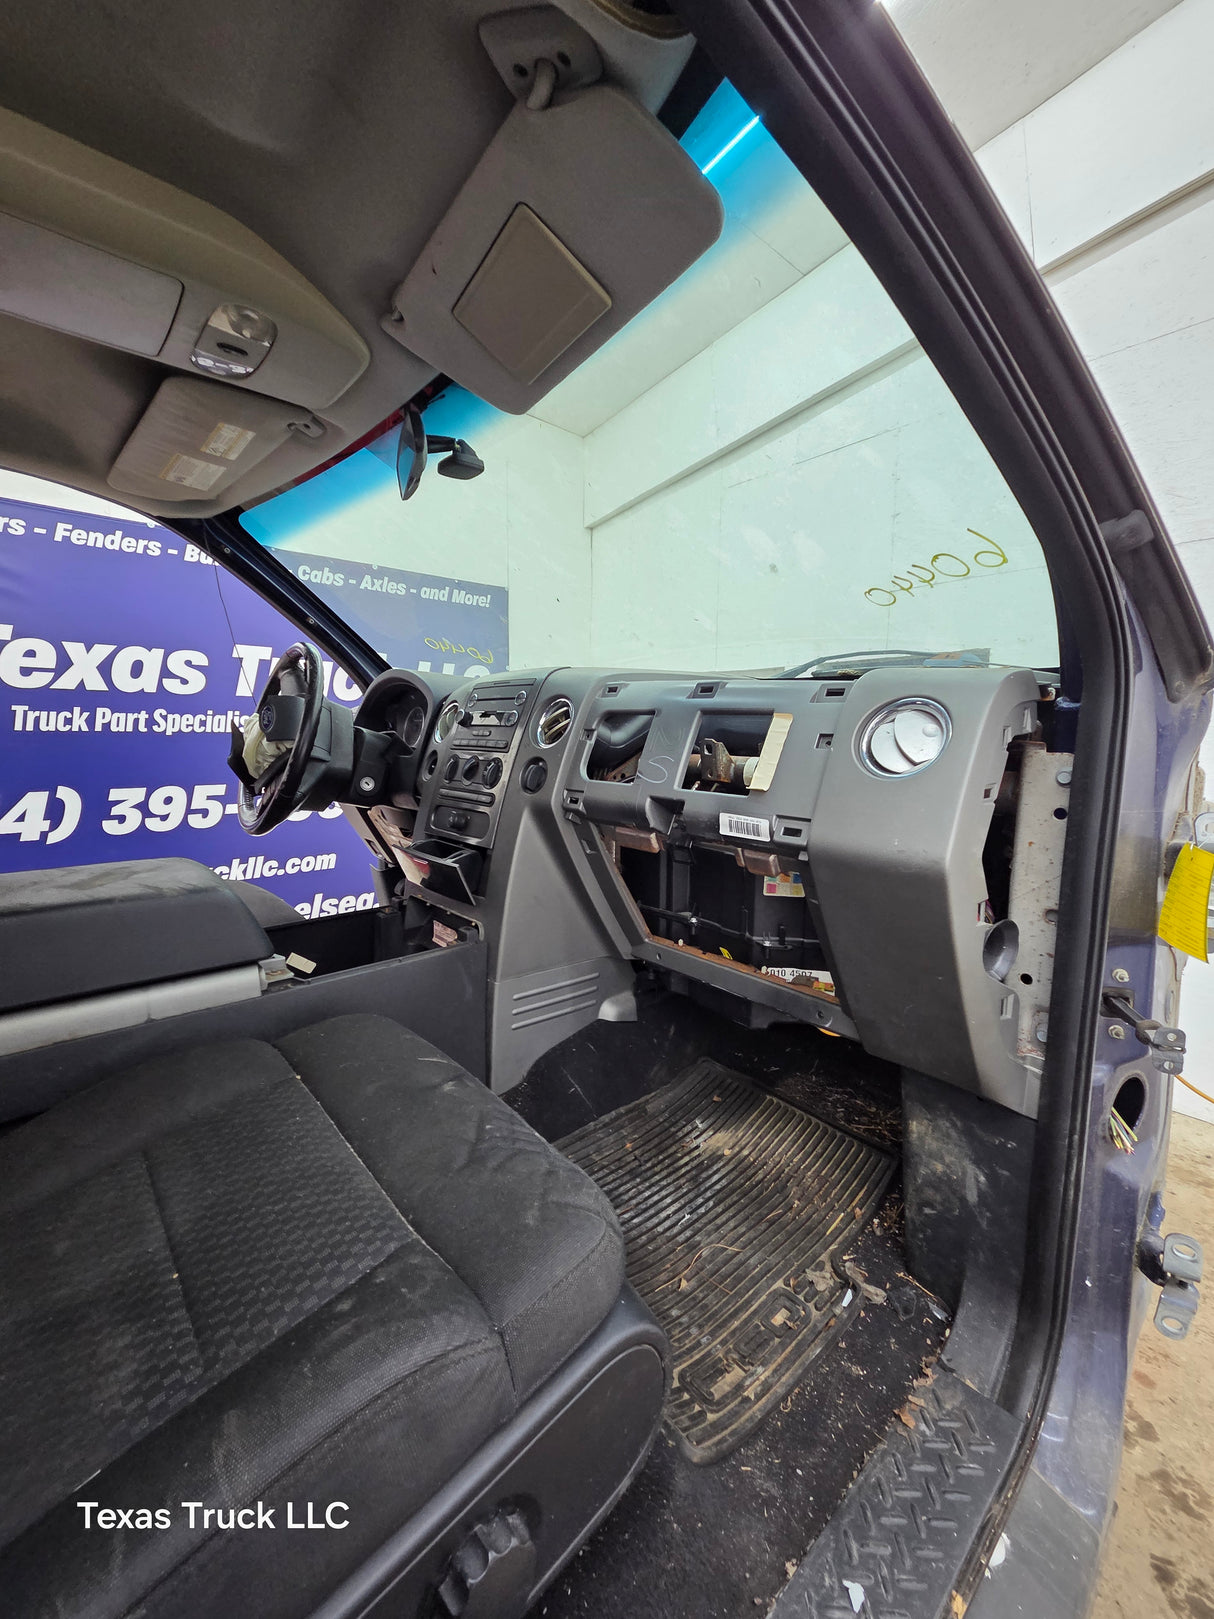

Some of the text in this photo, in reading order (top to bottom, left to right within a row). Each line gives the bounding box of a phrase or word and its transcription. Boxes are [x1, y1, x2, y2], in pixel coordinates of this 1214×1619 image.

[54, 523, 162, 557] Fenders
[183, 544, 220, 567] Bu
[297, 565, 345, 587] Cabs
[359, 575, 407, 596] Axles
[420, 587, 449, 602] and
[451, 589, 491, 608] More!
[0, 623, 209, 695] exas
[11, 705, 90, 732] Truck
[94, 707, 148, 733] Part
